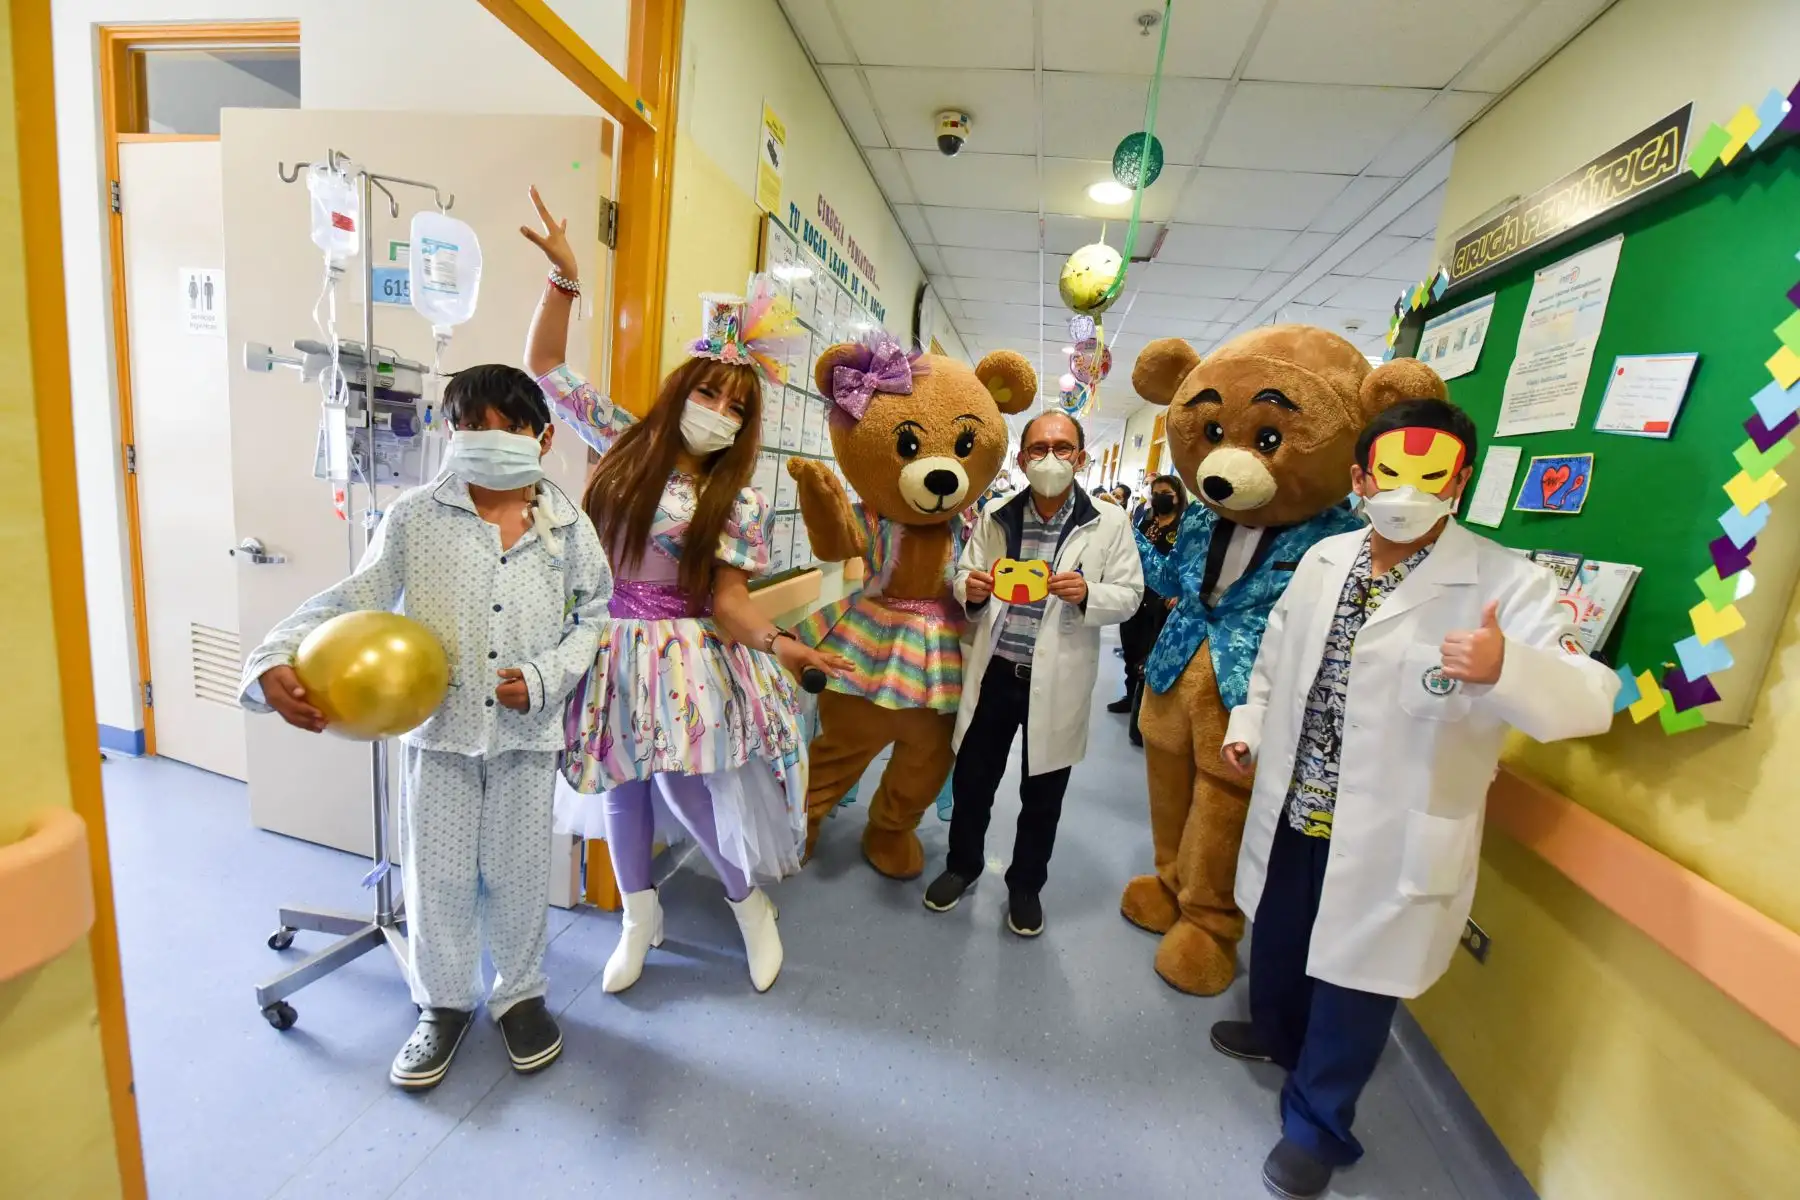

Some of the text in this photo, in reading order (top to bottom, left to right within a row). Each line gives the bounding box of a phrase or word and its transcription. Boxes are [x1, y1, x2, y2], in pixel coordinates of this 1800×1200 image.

[789, 201, 801, 233] TU
[803, 218, 827, 262] HOGAR
[829, 246, 849, 285] LEJOS
[851, 272, 860, 294] DE
[860, 285, 869, 306] TU
[1452, 126, 1679, 278] CIRUGÍA PEDIÁTRICA
